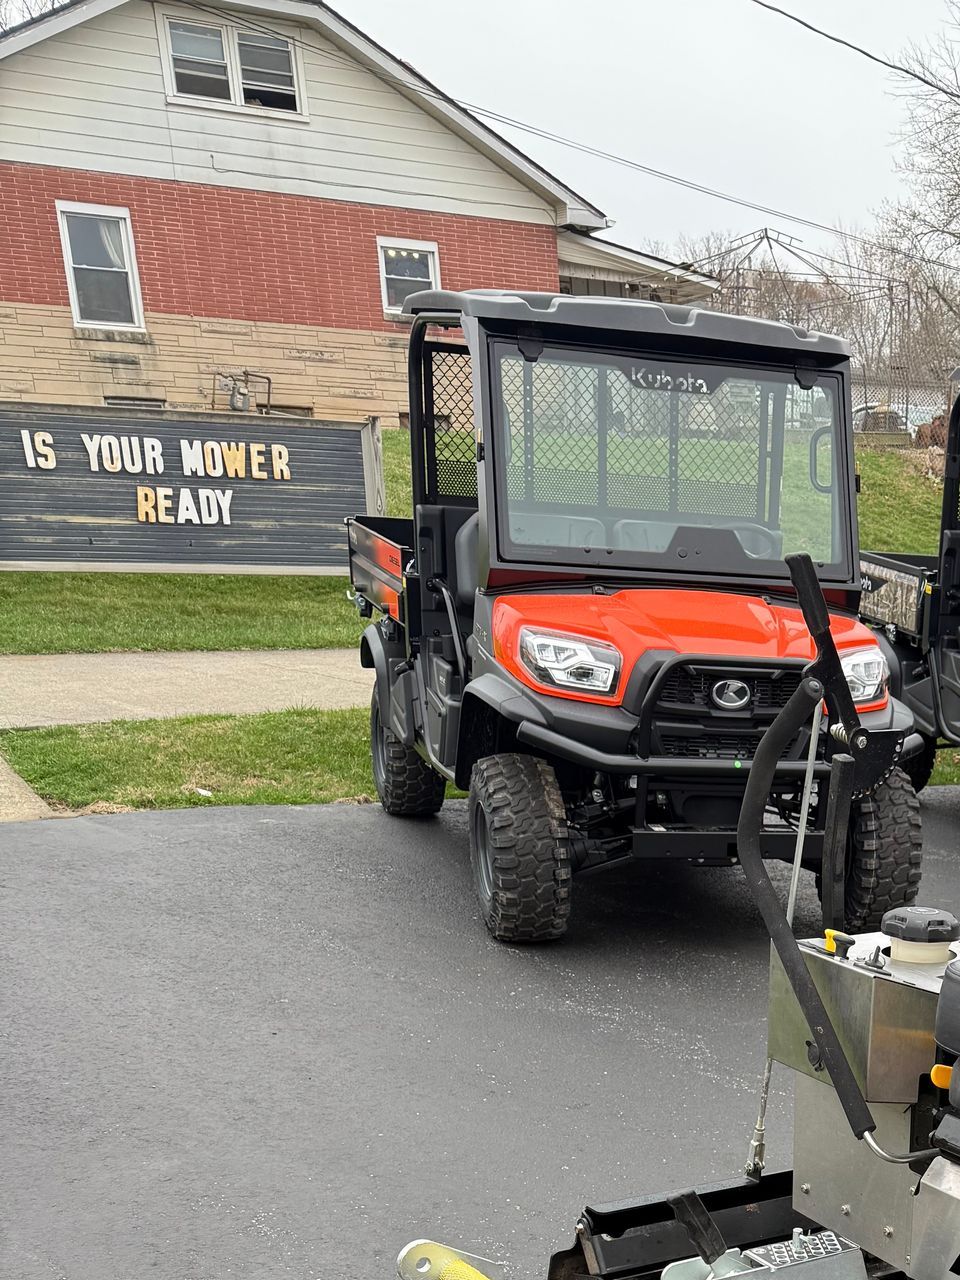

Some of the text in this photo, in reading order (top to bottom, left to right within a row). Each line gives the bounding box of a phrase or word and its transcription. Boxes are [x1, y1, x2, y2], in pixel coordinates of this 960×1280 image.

[631, 366, 708, 394] Kubota
[20, 429, 291, 480] IS YOUR MOWER
[136, 485, 234, 525] READY
